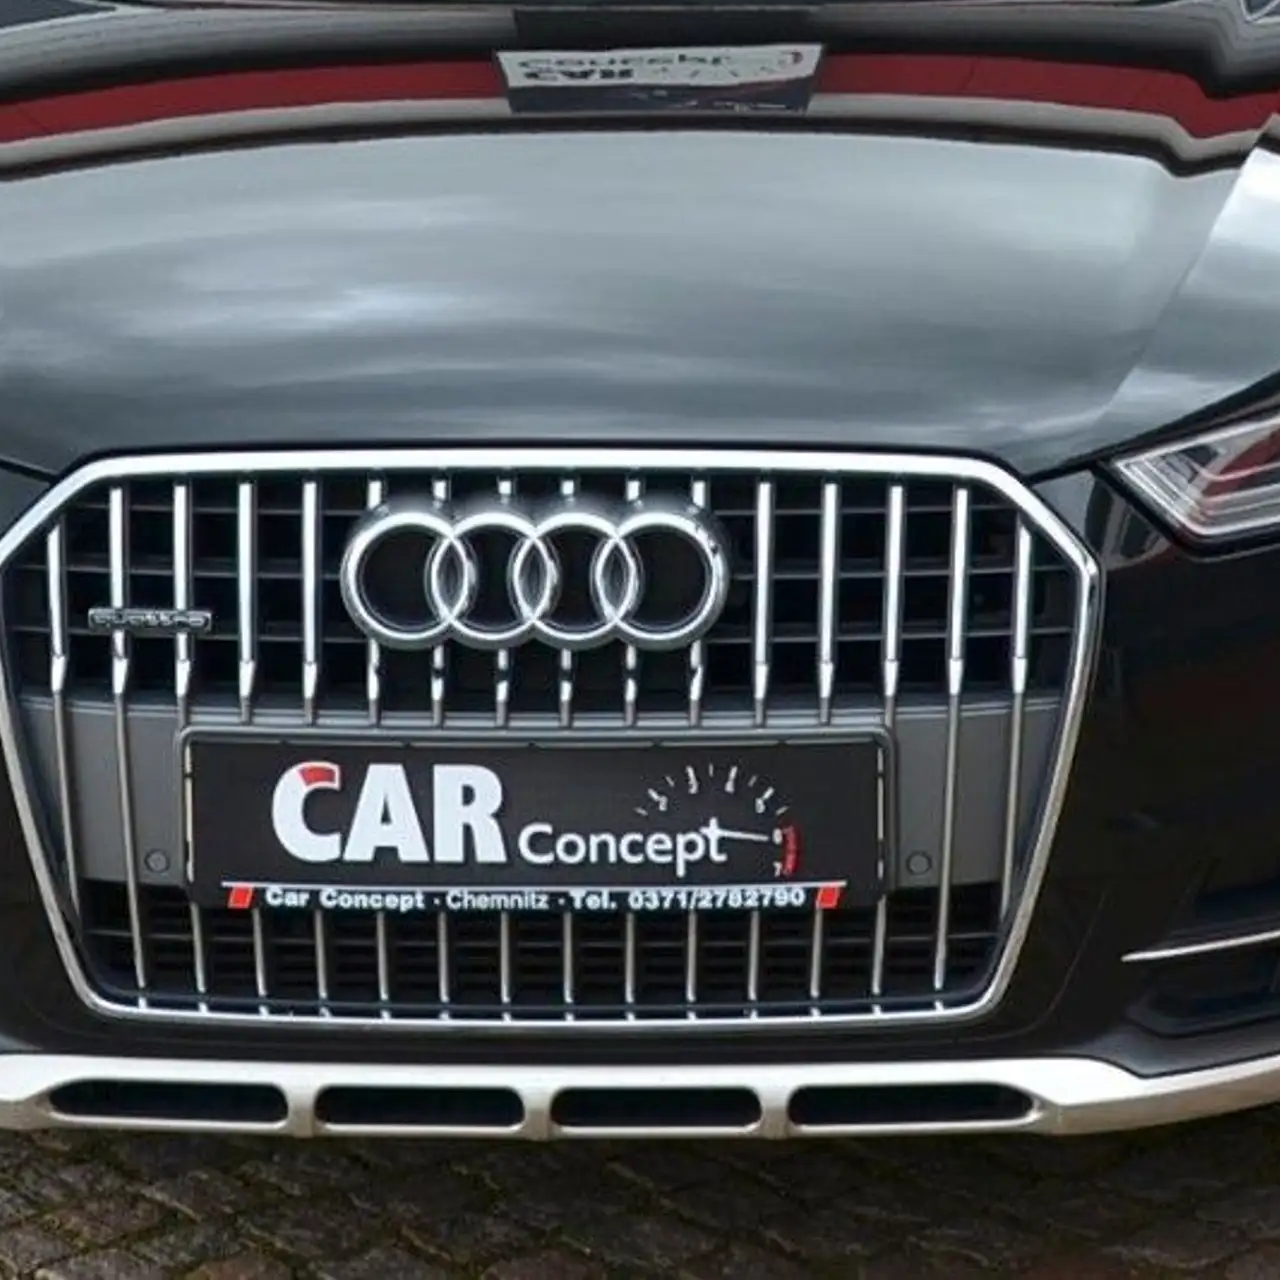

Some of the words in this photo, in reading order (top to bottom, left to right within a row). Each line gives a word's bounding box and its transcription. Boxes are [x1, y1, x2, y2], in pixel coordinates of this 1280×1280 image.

[272, 761, 508, 863] CAR
[517, 817, 729, 879] Concept
[265, 887, 310, 907] Car
[319, 888, 426, 912] Concept
[446, 889, 549, 910] Chemnitz
[570, 889, 618, 910] Tel.
[627, 887, 806, 910] 0371/2782790
